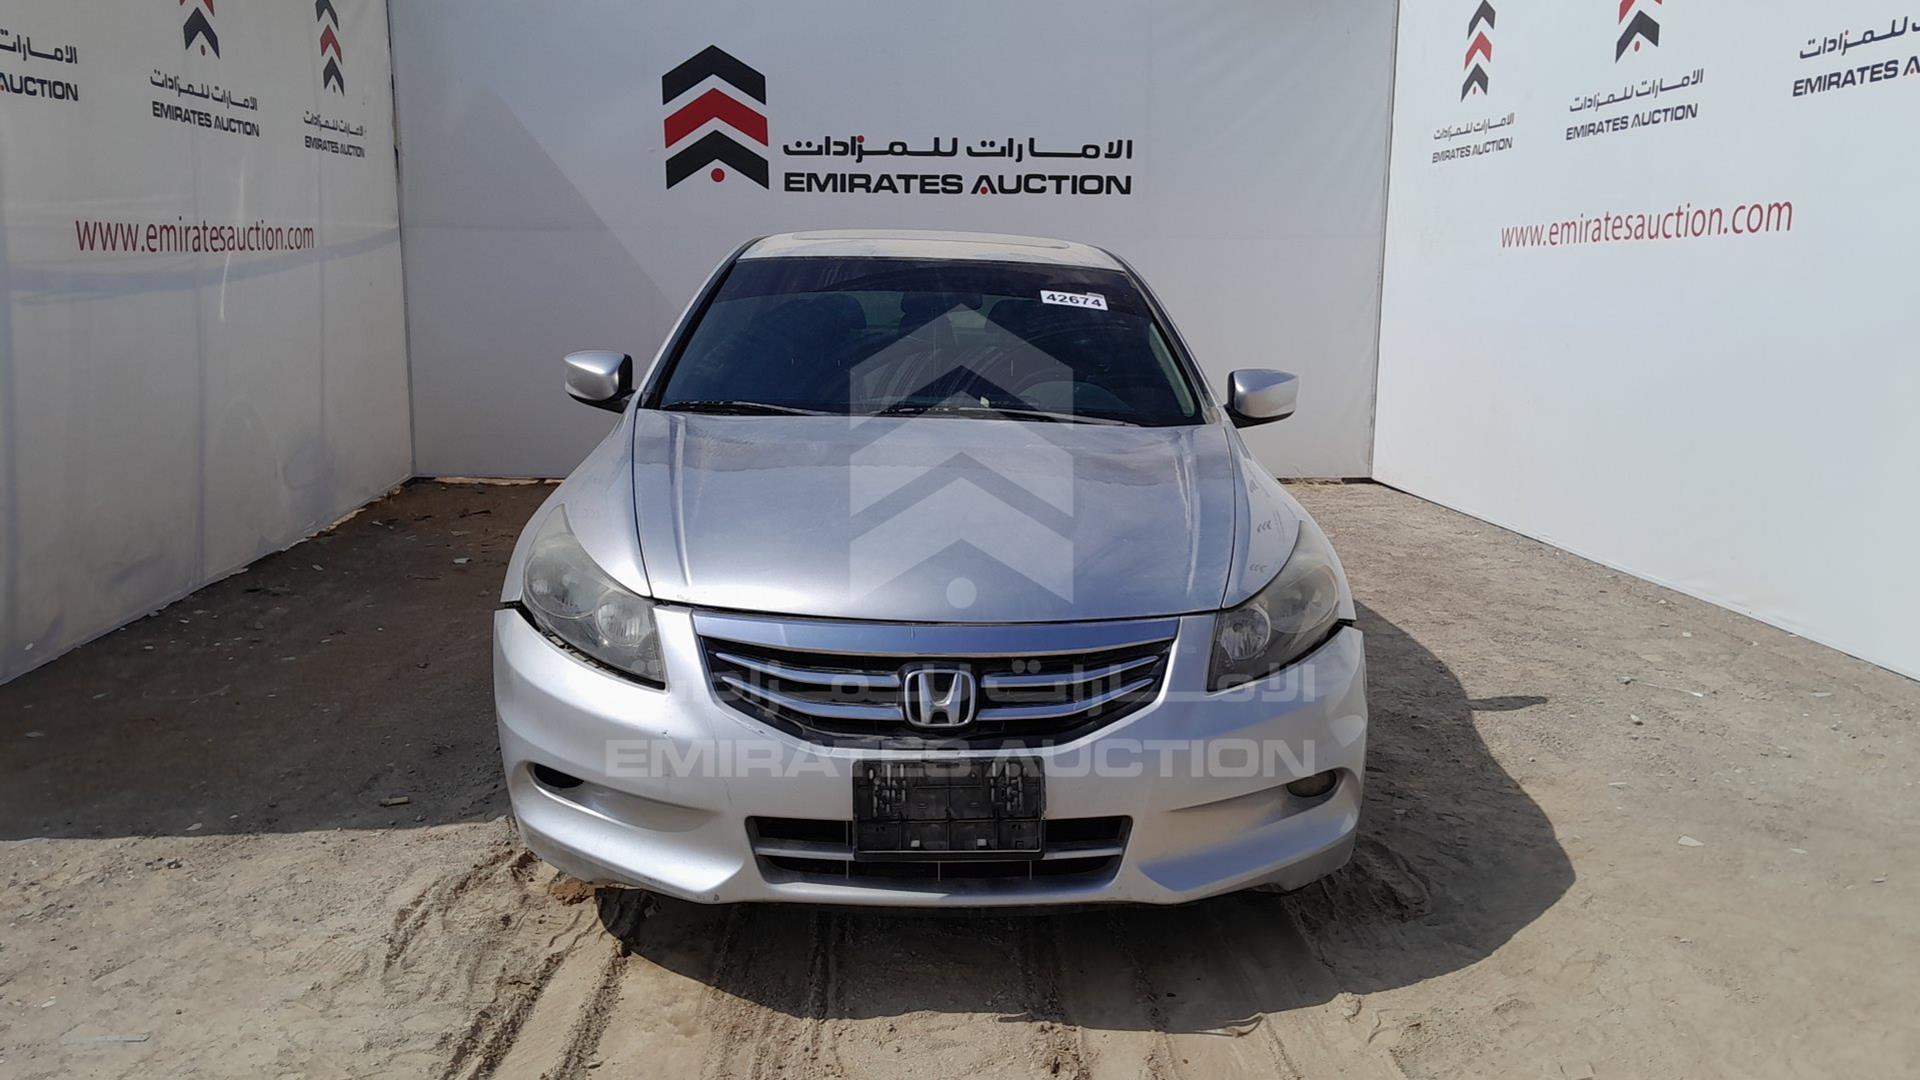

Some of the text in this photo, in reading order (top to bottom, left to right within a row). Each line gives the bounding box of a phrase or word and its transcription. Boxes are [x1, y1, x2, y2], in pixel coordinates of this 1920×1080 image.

[1792, 58, 1899, 98] EMIRATES
[151, 100, 260, 138] EMIRATES AUCTION
[1565, 102, 1699, 141] EMIRATES AUCTION
[304, 134, 366, 158] EMIRATES AUCTION
[1431, 136, 1514, 164] EMIRATES AUCTION
[783, 172, 1133, 196] EMIRATES AUCTION
[75, 215, 316, 253] www.emiratesauction.com
[1501, 200, 1794, 249] www.emiratesauction.com
[1046, 293, 1102, 307] 42674
